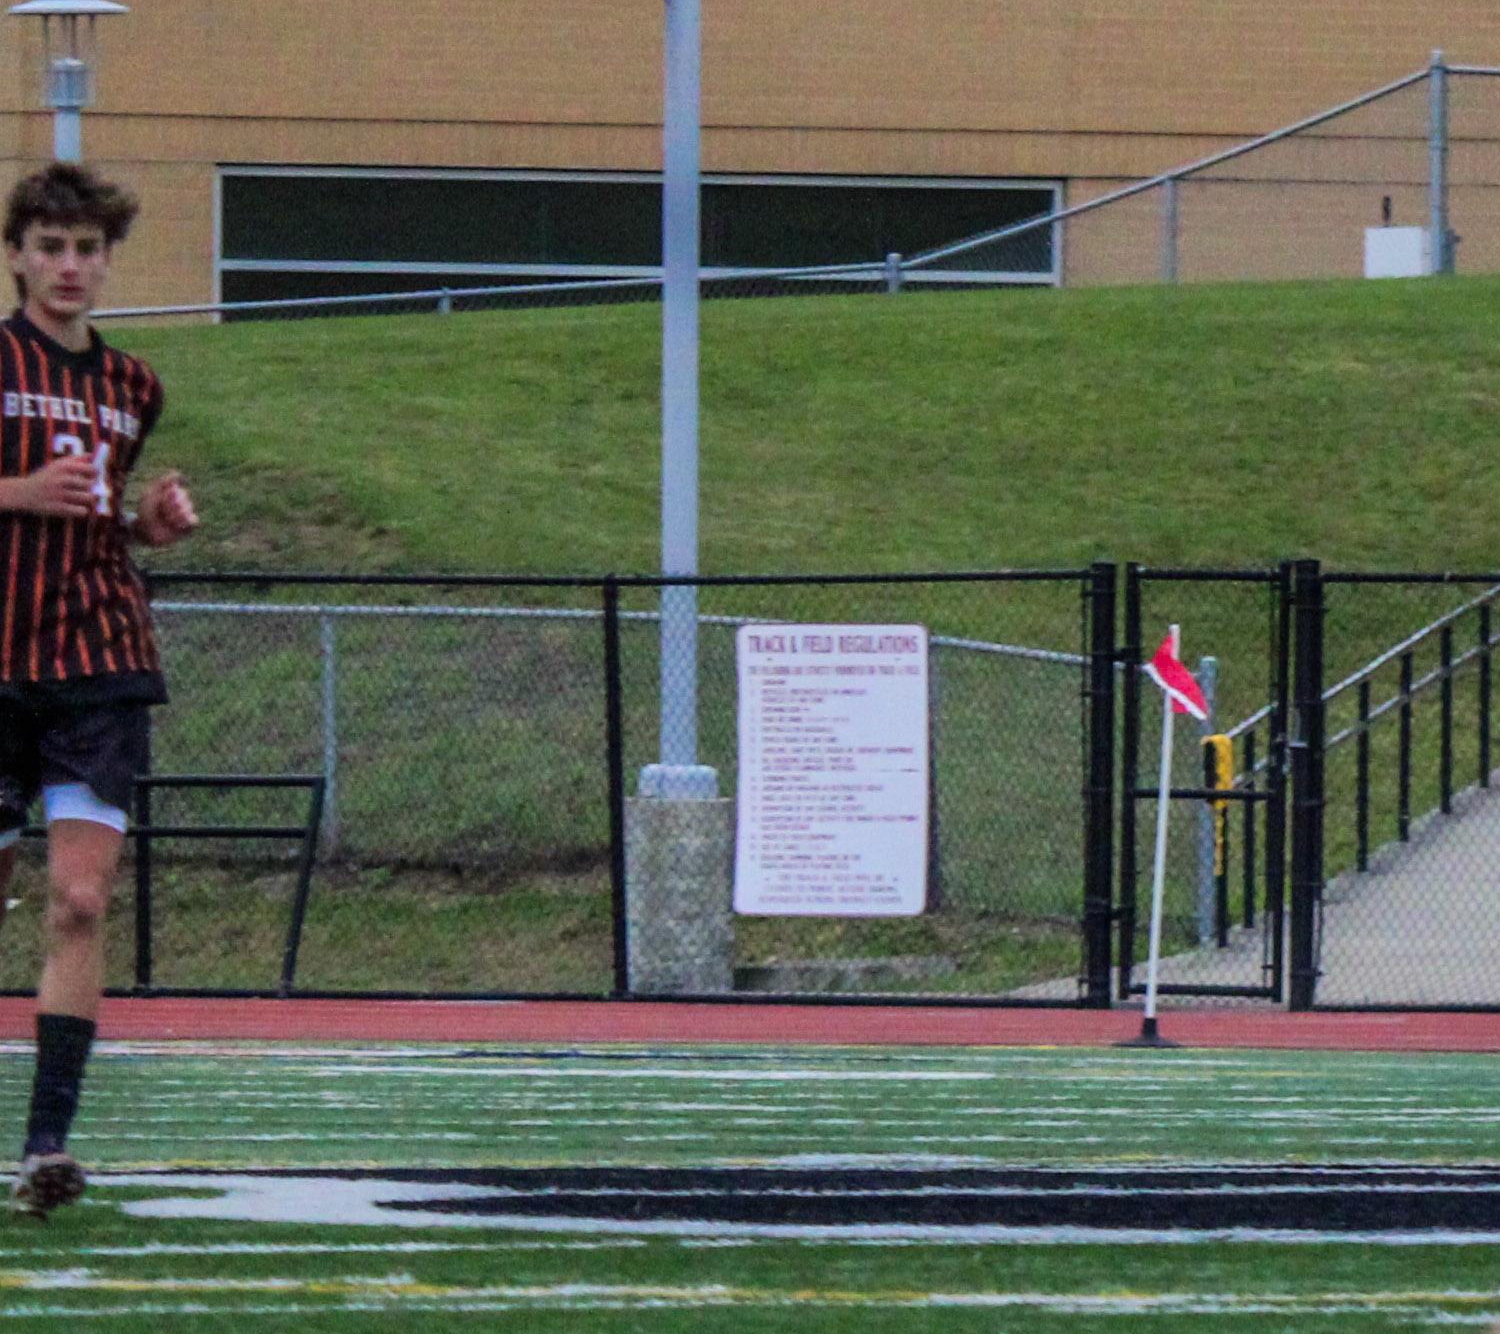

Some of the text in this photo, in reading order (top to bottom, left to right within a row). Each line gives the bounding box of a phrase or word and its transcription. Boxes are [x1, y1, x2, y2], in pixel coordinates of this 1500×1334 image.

[3, 392, 93, 425] BETHEL
[747, 635, 785, 653] TRACK
[803, 635, 831, 653] FIELD
